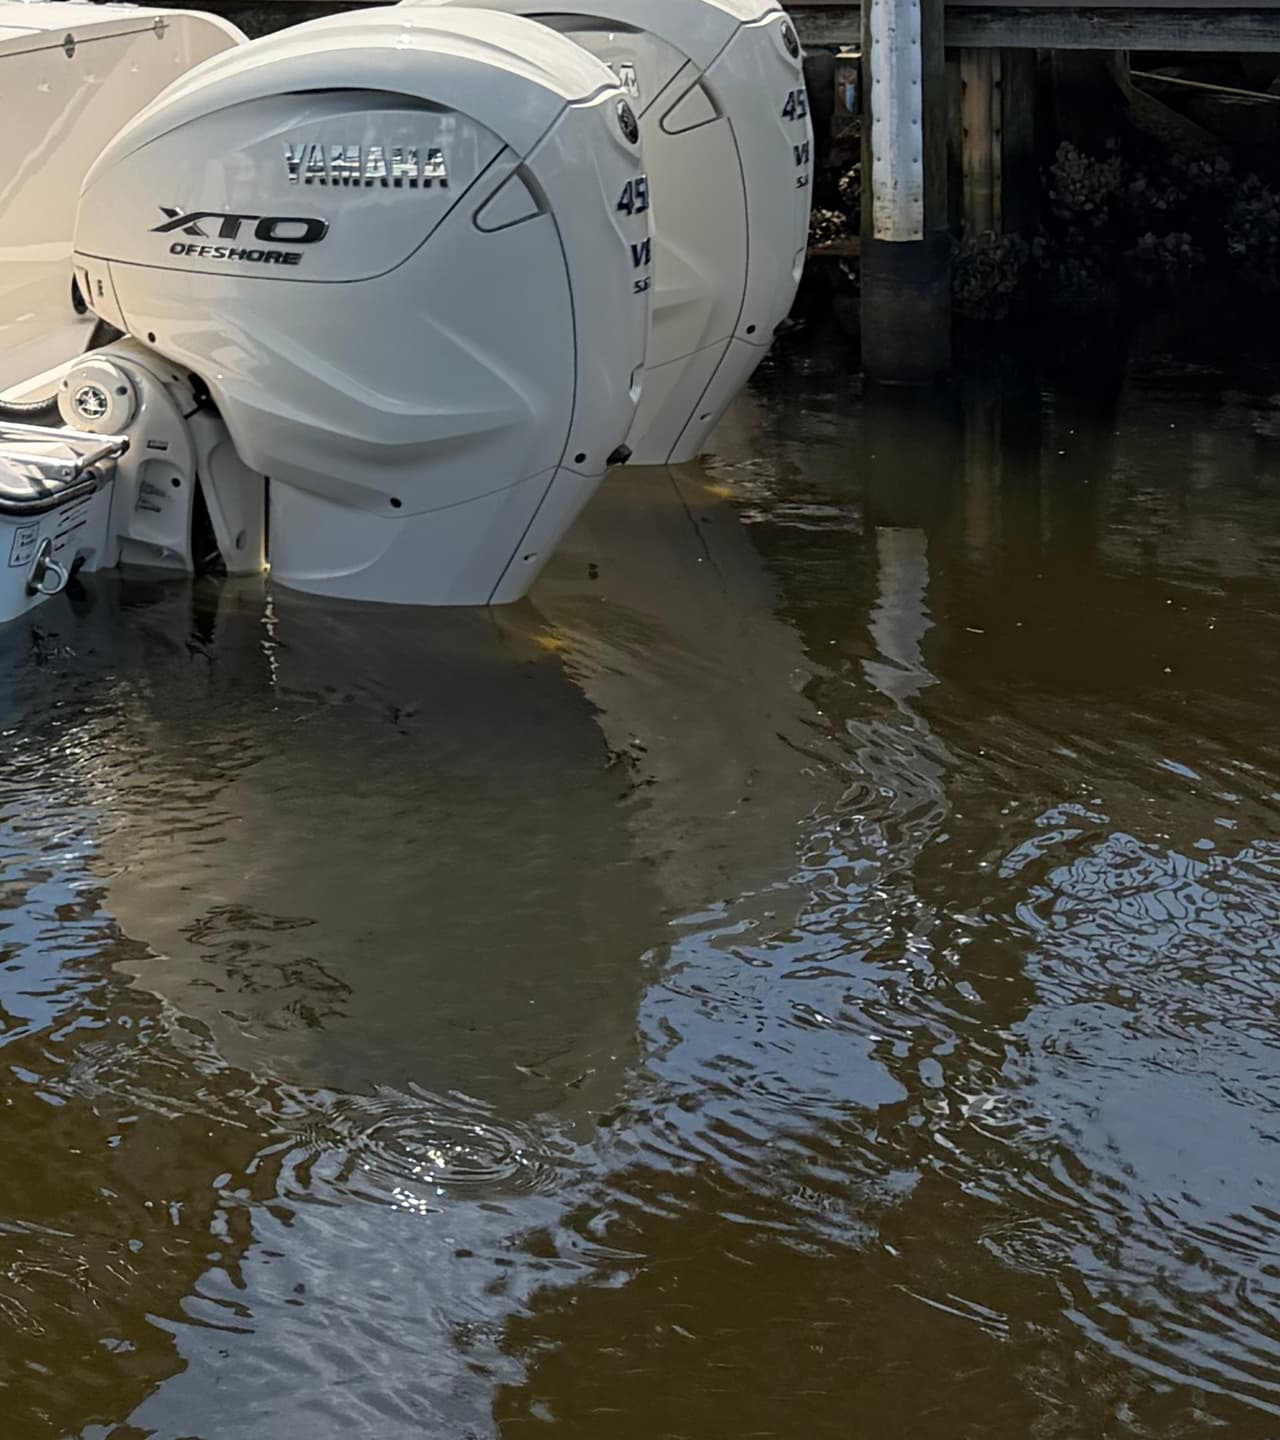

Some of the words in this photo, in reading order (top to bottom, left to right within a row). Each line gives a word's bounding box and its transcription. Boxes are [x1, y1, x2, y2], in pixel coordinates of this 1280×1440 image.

[782, 88, 807, 122] 45
[283, 142, 450, 189] YAMAHA
[616, 174, 650, 216] 45
[147, 205, 330, 245] XTO
[169, 242, 306, 265] OFFSHORE
